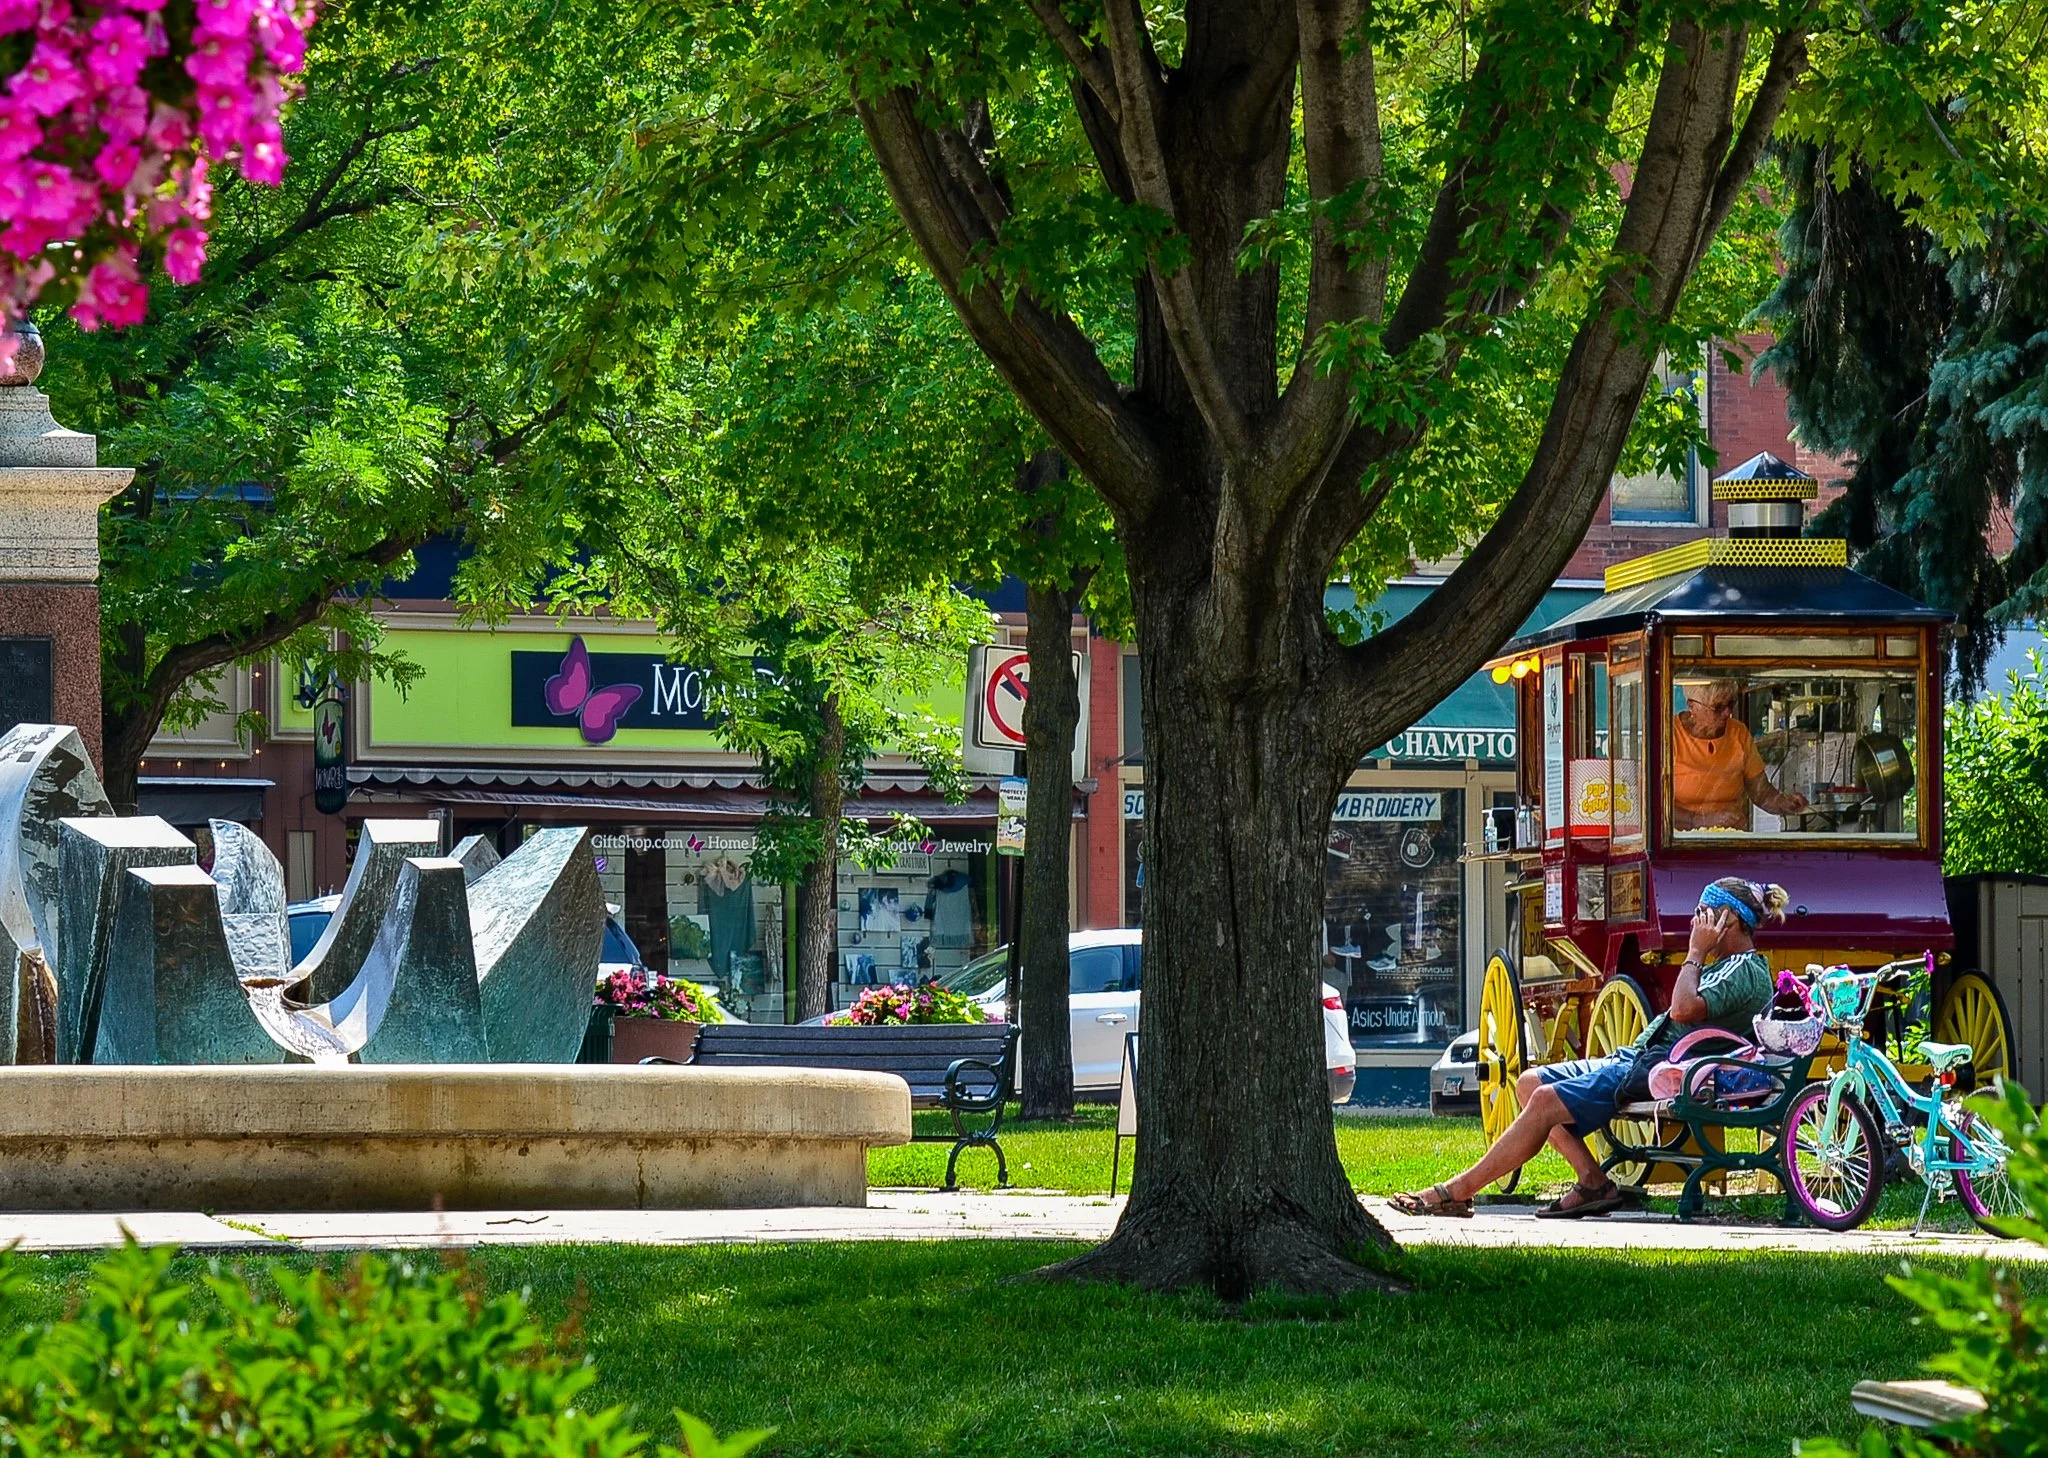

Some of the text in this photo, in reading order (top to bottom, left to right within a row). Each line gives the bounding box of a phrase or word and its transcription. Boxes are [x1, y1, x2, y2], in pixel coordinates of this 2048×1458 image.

[708, 835, 749, 849] Home
[939, 838, 993, 855] Jewelry
[1411, 1006, 1447, 1027] Amour
